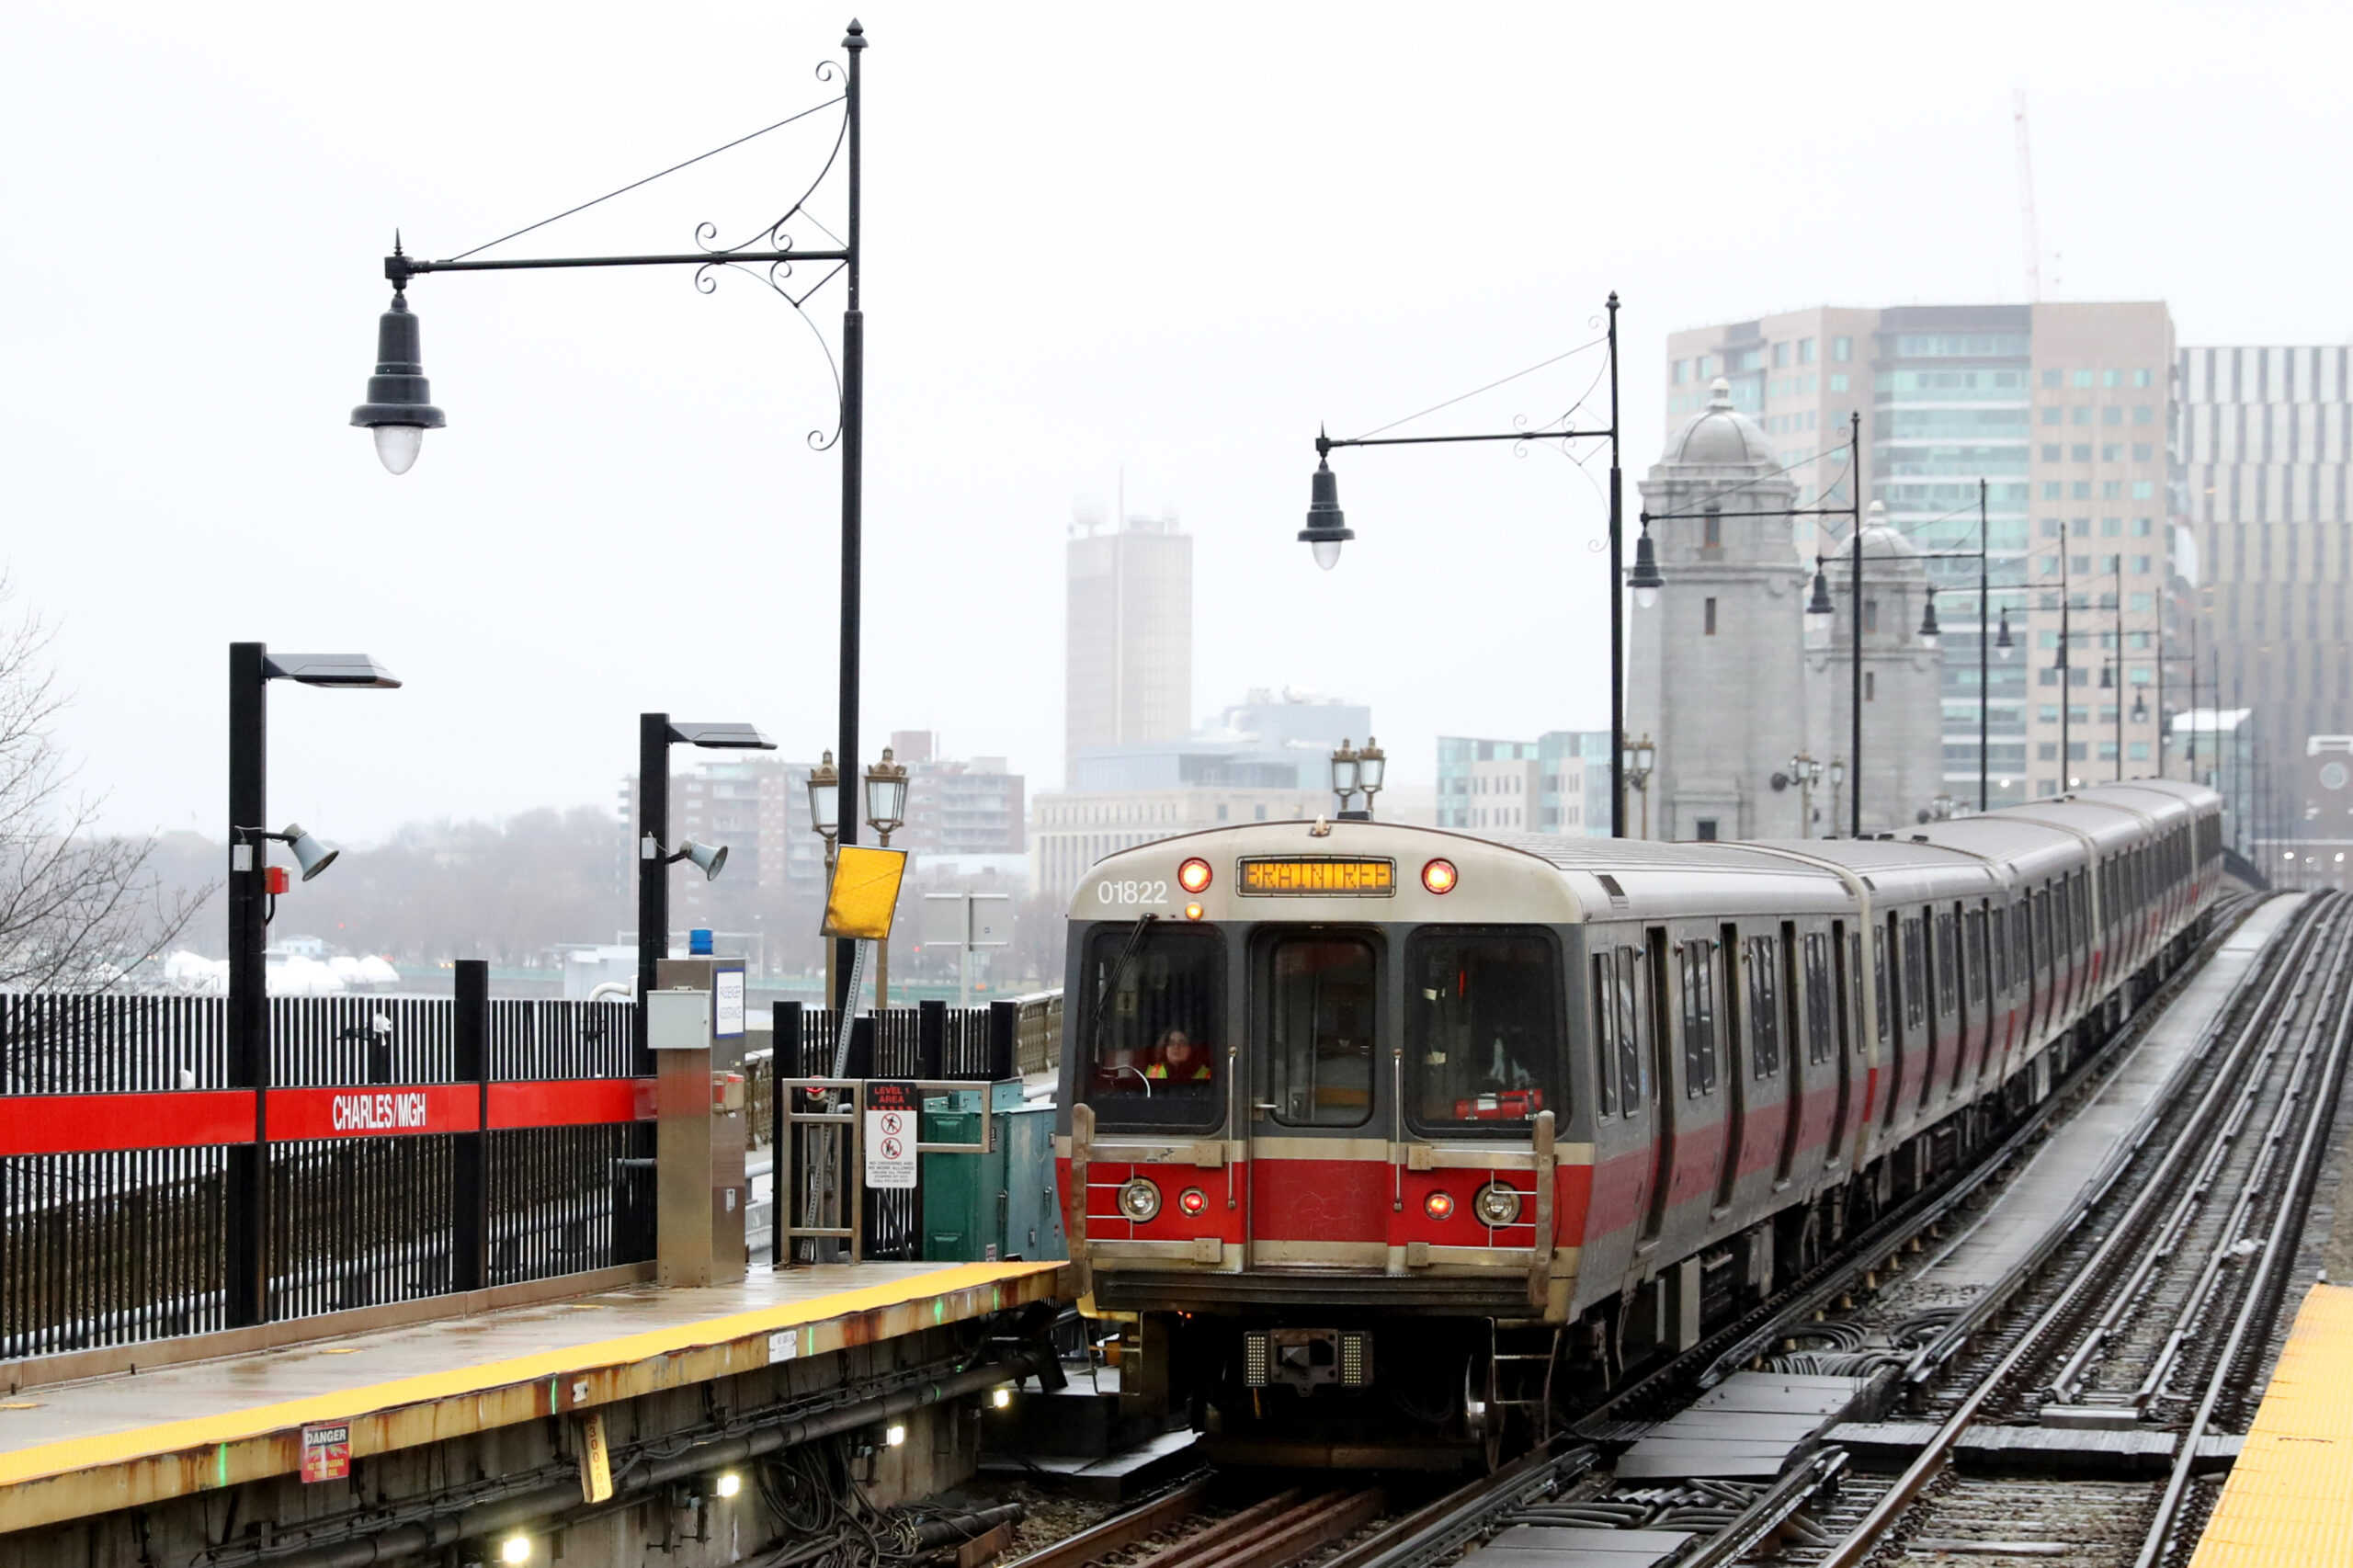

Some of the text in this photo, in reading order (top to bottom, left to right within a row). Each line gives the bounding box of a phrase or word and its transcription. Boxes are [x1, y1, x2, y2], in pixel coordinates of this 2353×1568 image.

[1246, 862, 1392, 889] BRAINTREE
[1097, 880, 1168, 904] 01822
[874, 1086, 910, 1095] LEVEL 1
[879, 1095, 904, 1104] AREA
[333, 1092, 426, 1131] CHARLES/MGH
[306, 1428, 347, 1445] DANGER
